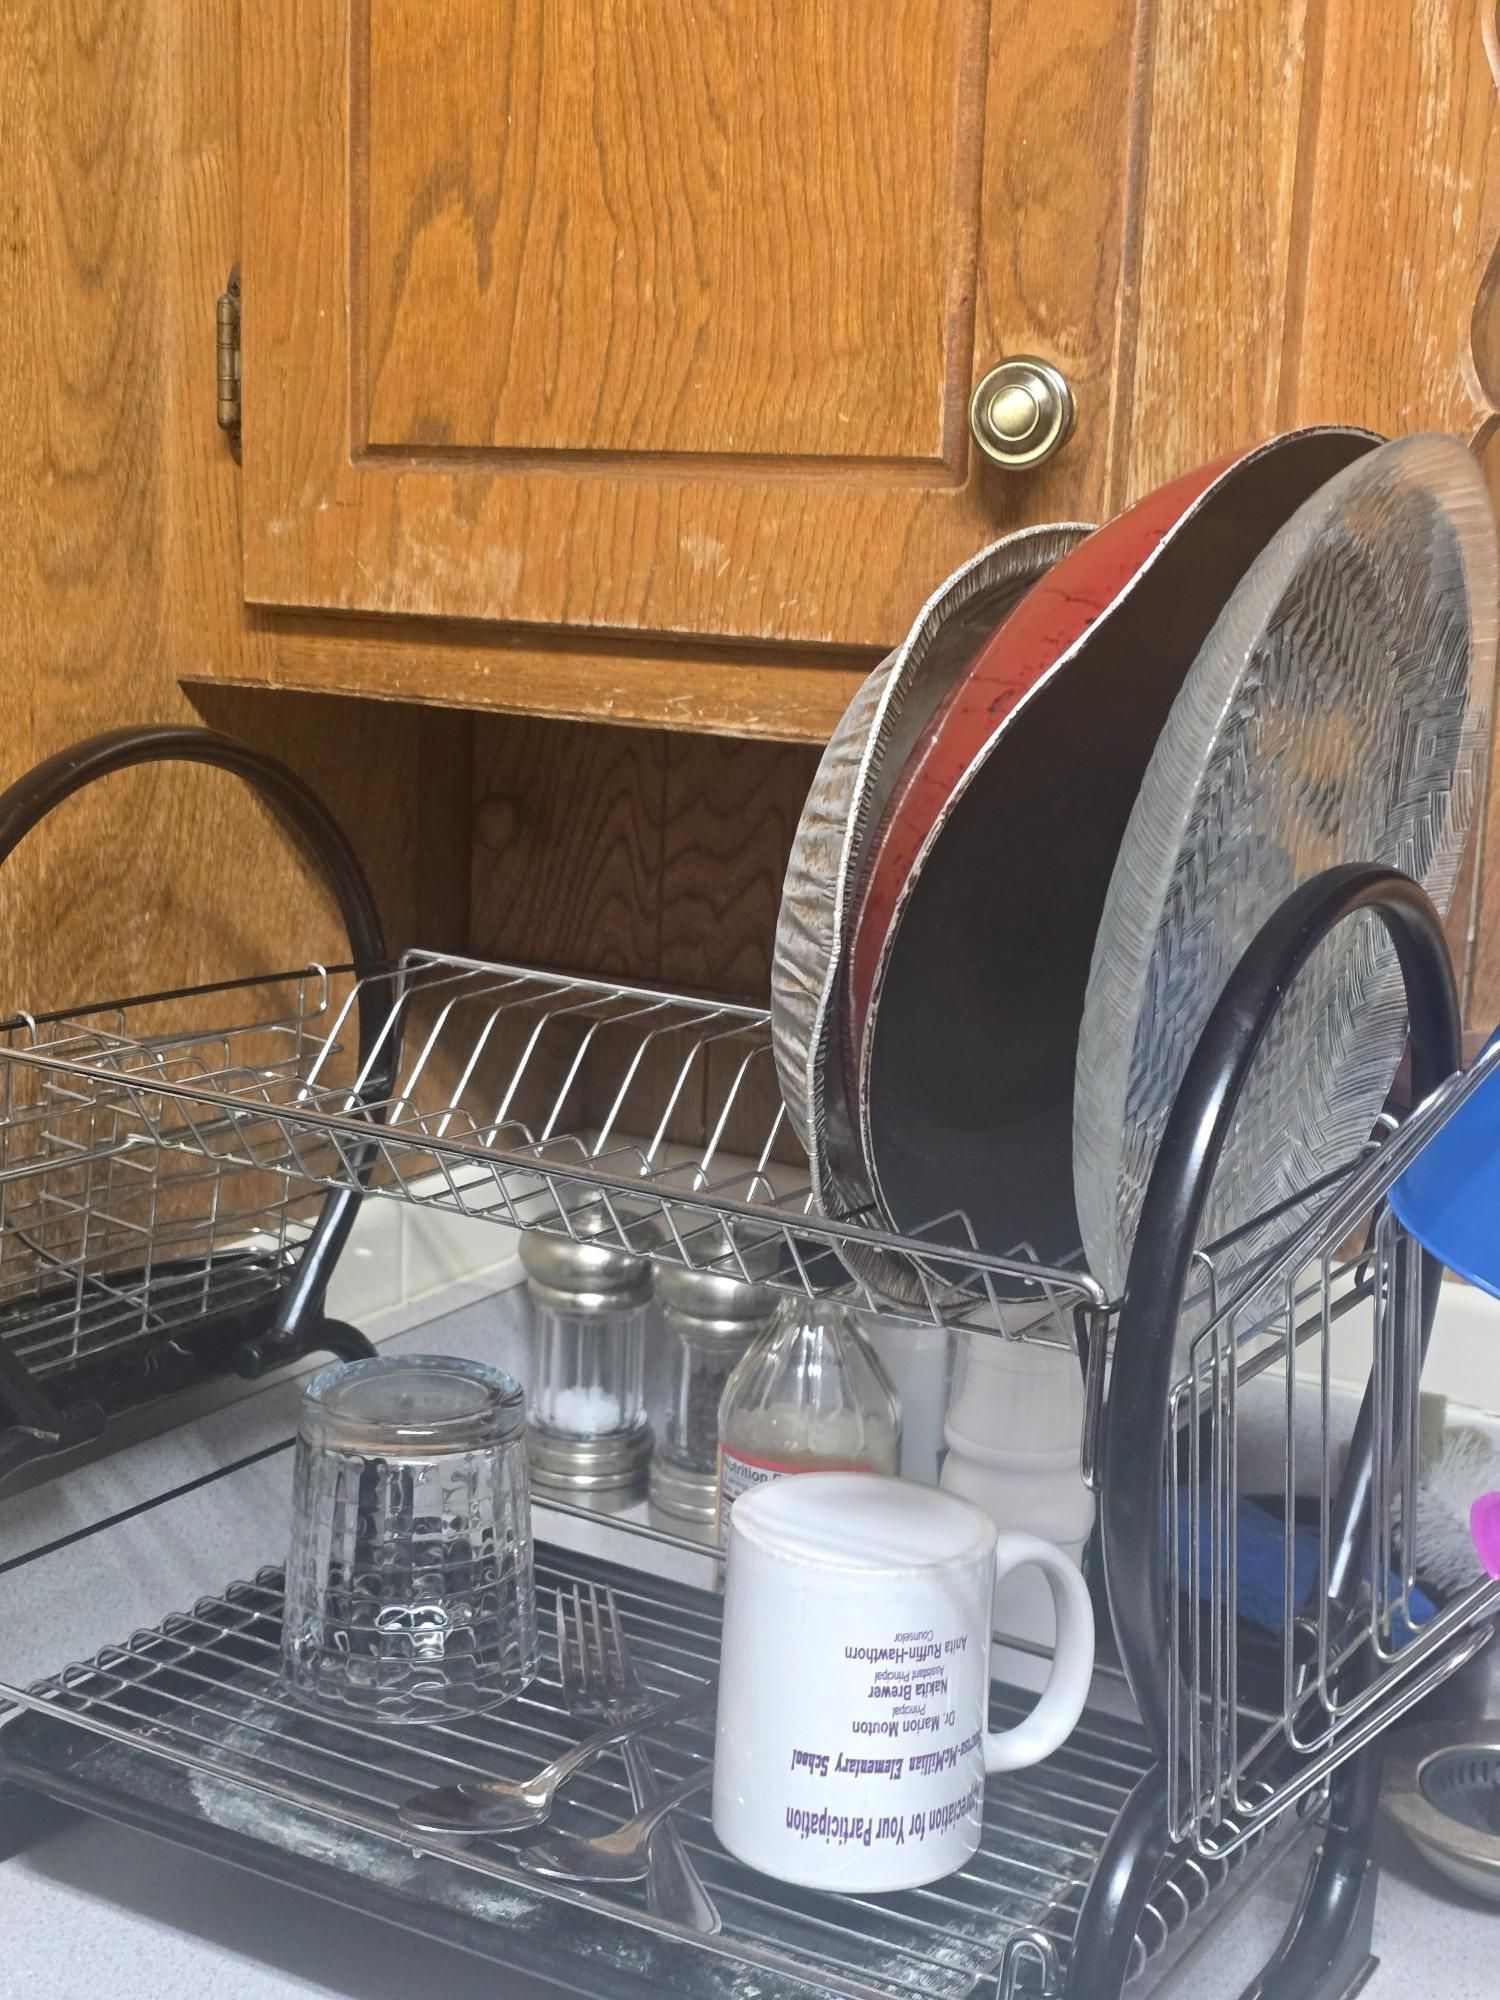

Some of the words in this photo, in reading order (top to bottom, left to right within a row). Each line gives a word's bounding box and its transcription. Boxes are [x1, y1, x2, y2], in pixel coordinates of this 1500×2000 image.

[894, 1630, 934, 1643] Counselor
[944, 1634, 968, 1654] Anita
[845, 1642, 942, 1664] Ruffin-Hawthorn
[874, 1669, 910, 1683] Principal
[912, 1665, 945, 1681] Assistant
[868, 1684, 912, 1700] Brewer
[915, 1679, 948, 1698] Nakita
[892, 1704, 926, 1717] Principal
[944, 1710, 955, 1726] Dr.
[852, 1720, 899, 1737] Mouton
[903, 1715, 940, 1734] Marion
[791, 1749, 830, 1777] School
[835, 1752, 903, 1780] Elementary
[786, 1806, 872, 1846] Participation
[876, 1812, 905, 1845] Your
[909, 1812, 926, 1841] for
